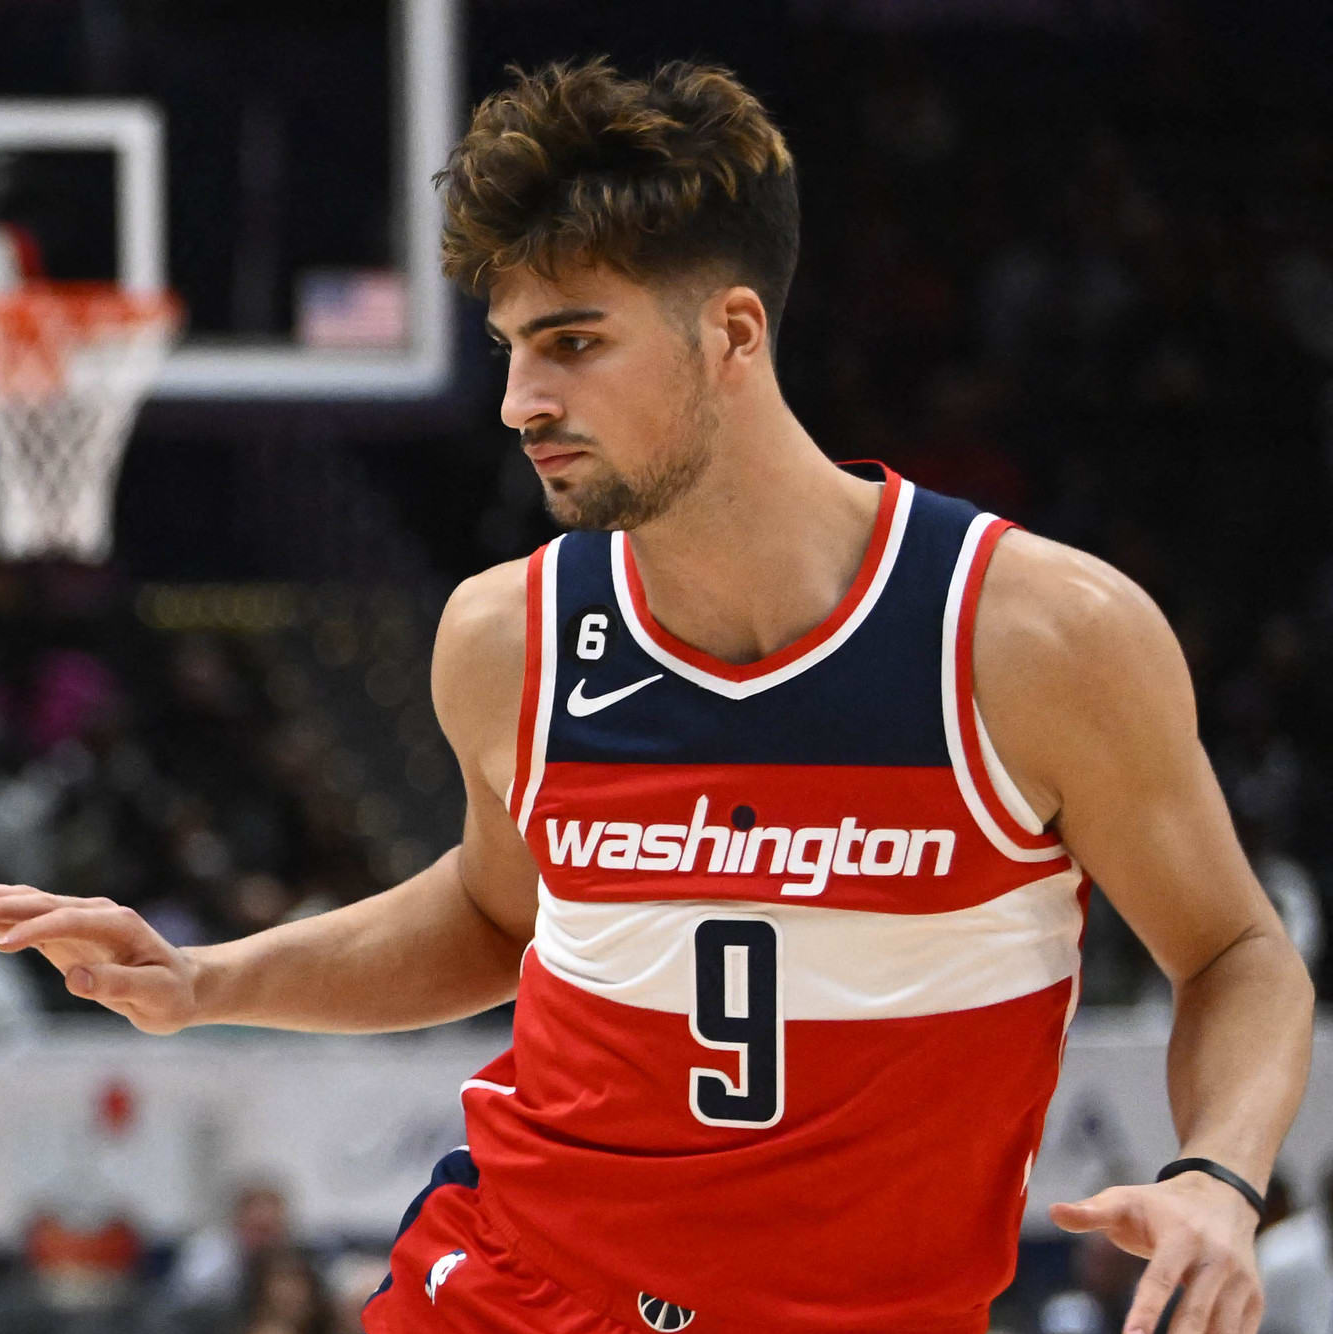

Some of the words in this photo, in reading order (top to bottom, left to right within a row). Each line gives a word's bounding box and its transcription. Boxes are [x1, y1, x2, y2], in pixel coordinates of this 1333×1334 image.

[576, 613, 608, 660] 6
[546, 795, 955, 896] washington
[688, 912, 785, 1128] 9
